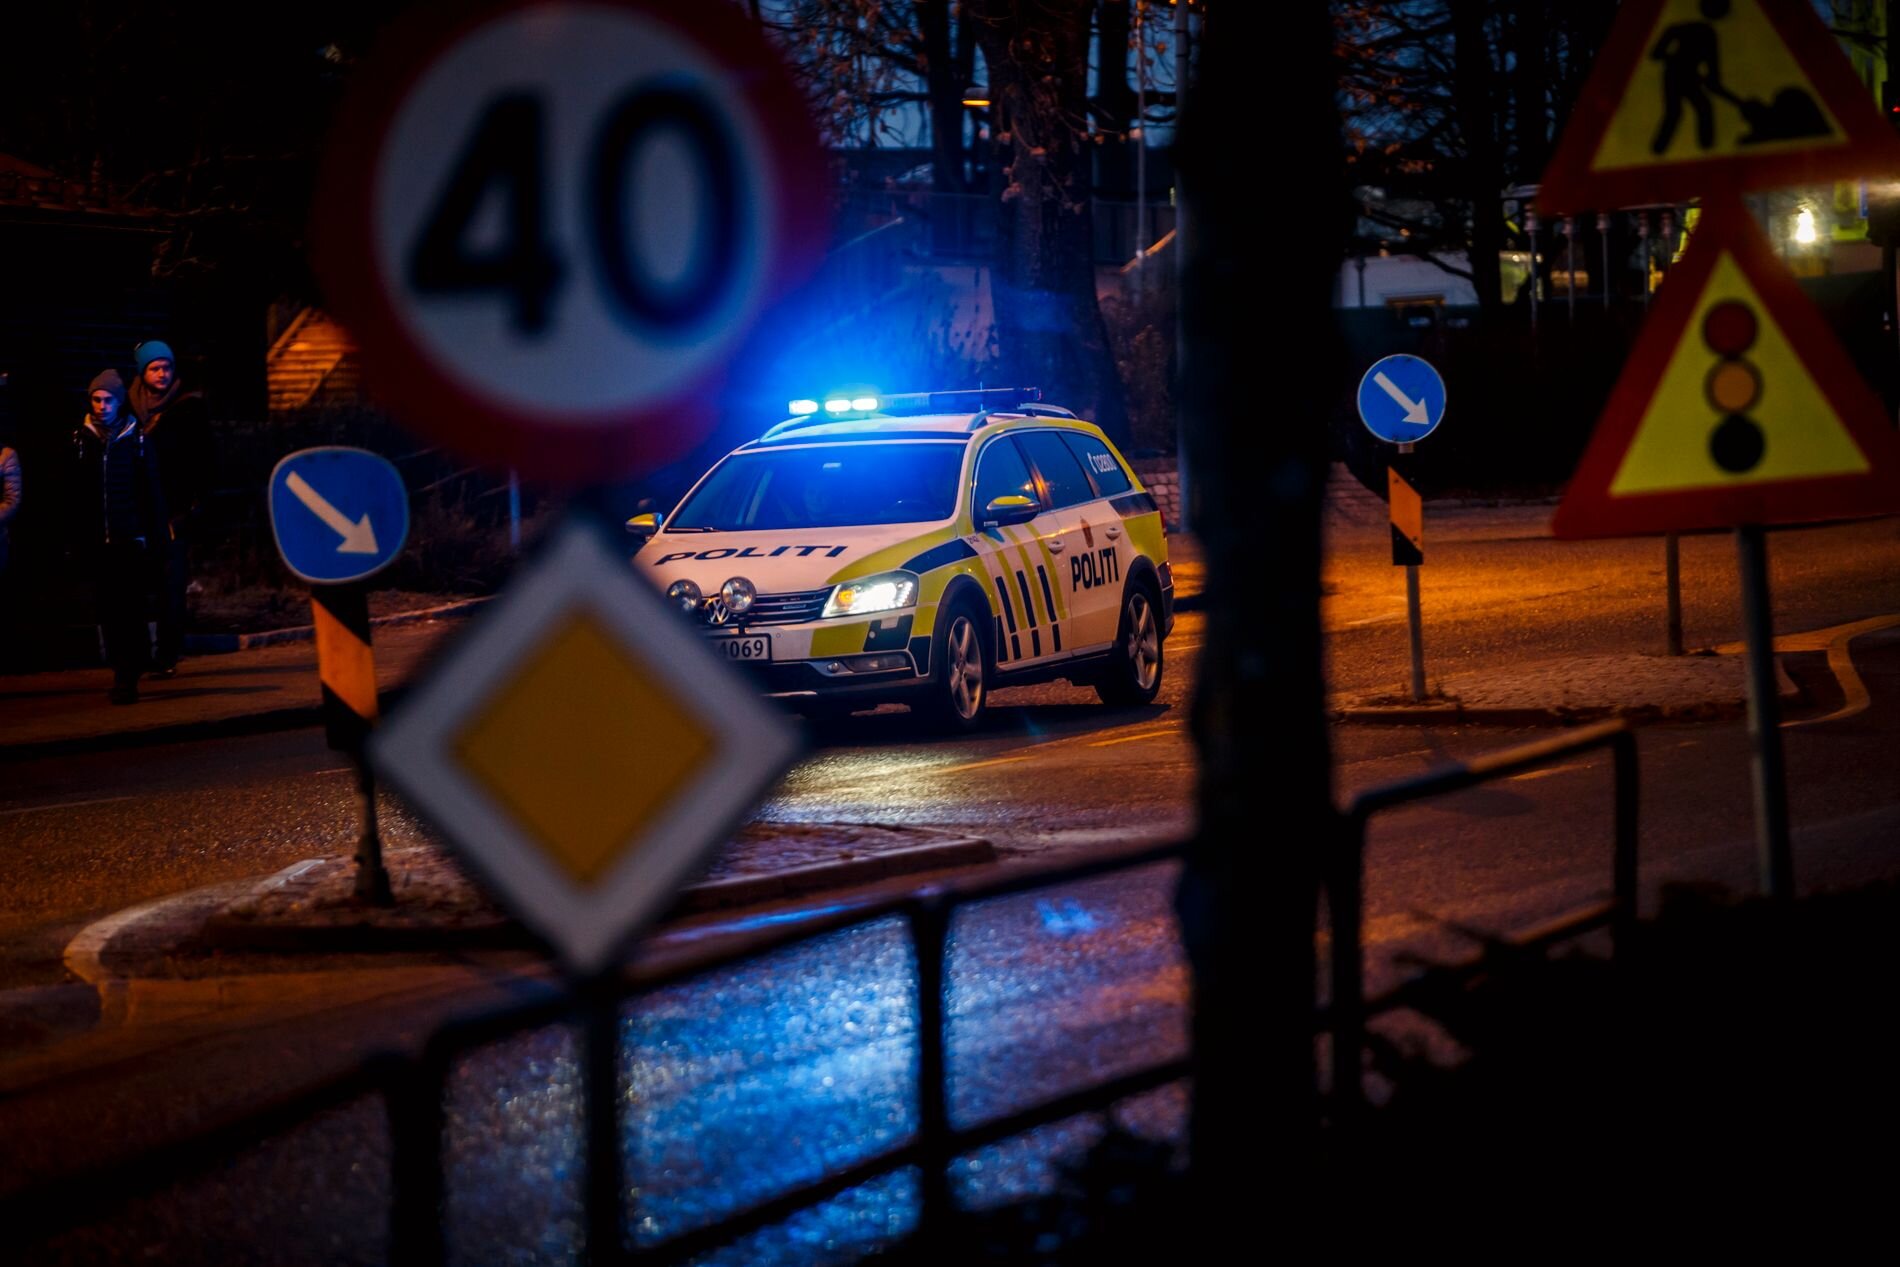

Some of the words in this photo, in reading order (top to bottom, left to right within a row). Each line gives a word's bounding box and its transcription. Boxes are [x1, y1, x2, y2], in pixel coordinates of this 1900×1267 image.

[408, 77, 753, 344] 40
[653, 545, 849, 566] POLITI
[1070, 547, 1120, 592] POLITI
